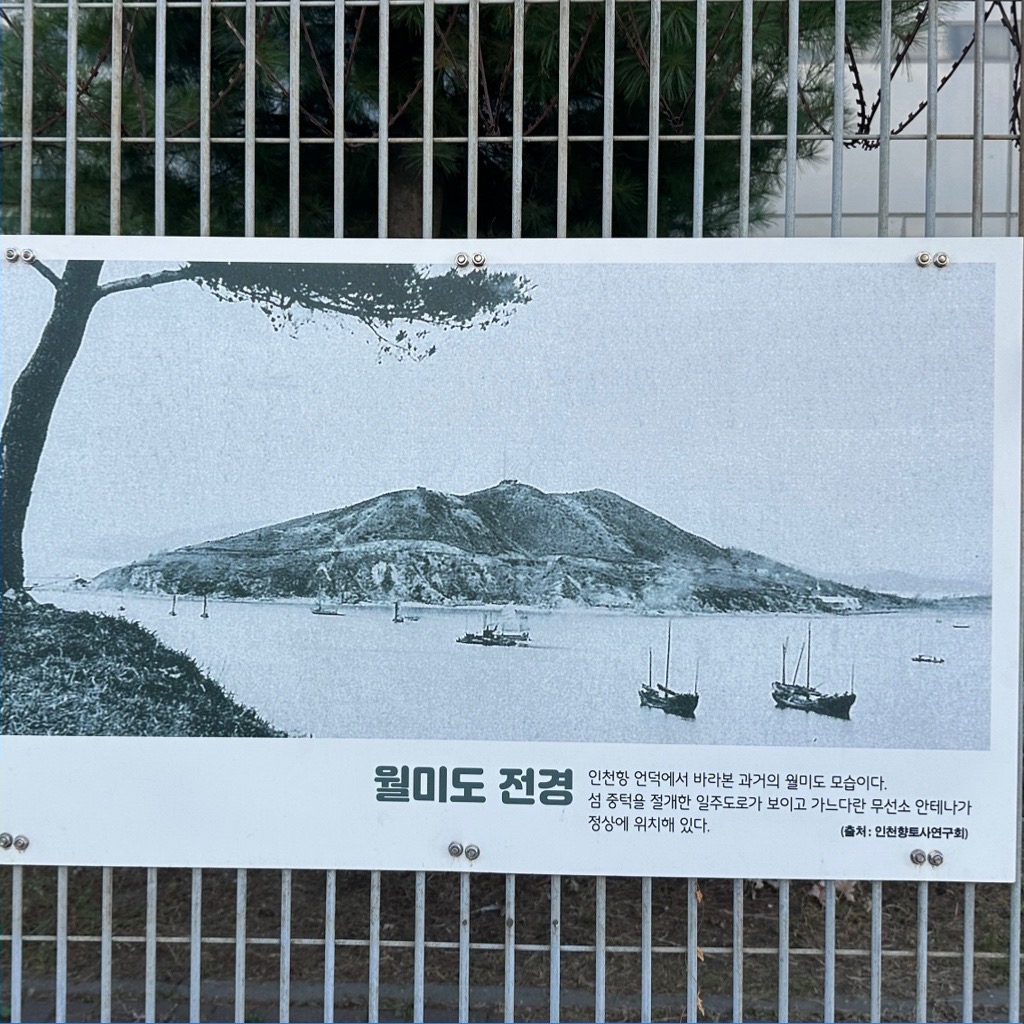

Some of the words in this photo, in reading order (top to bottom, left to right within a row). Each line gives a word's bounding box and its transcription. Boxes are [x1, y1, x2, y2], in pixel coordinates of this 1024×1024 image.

[374, 765, 487, 803] 월미도
[498, 767, 574, 806] 전경
[588, 769, 630, 787] 인천항
[634, 770, 689, 788] 언덕에서
[693, 771, 735, 789] 바라본
[738, 773, 780, 789] 과거의
[785, 773, 826, 790] 월미도
[830, 774, 888, 791] 모습이다.
[588, 793, 601, 809] 섬
[606, 793, 646, 810] 중턱을
[650, 794, 691, 811] 절개한
[696, 794, 763, 812] 일주도로가
[767, 796, 807, 812] 보이고
[811, 797, 867, 814] 가느다란
[870, 798, 911, 815] 무선소
[915, 798, 973, 816] 안테나가
[588, 815, 629, 832] 정상에
[634, 816, 675, 833] 위치해
[679, 817, 710, 834] 있다.
[874, 826, 969, 840] 인천향토사연구회)
